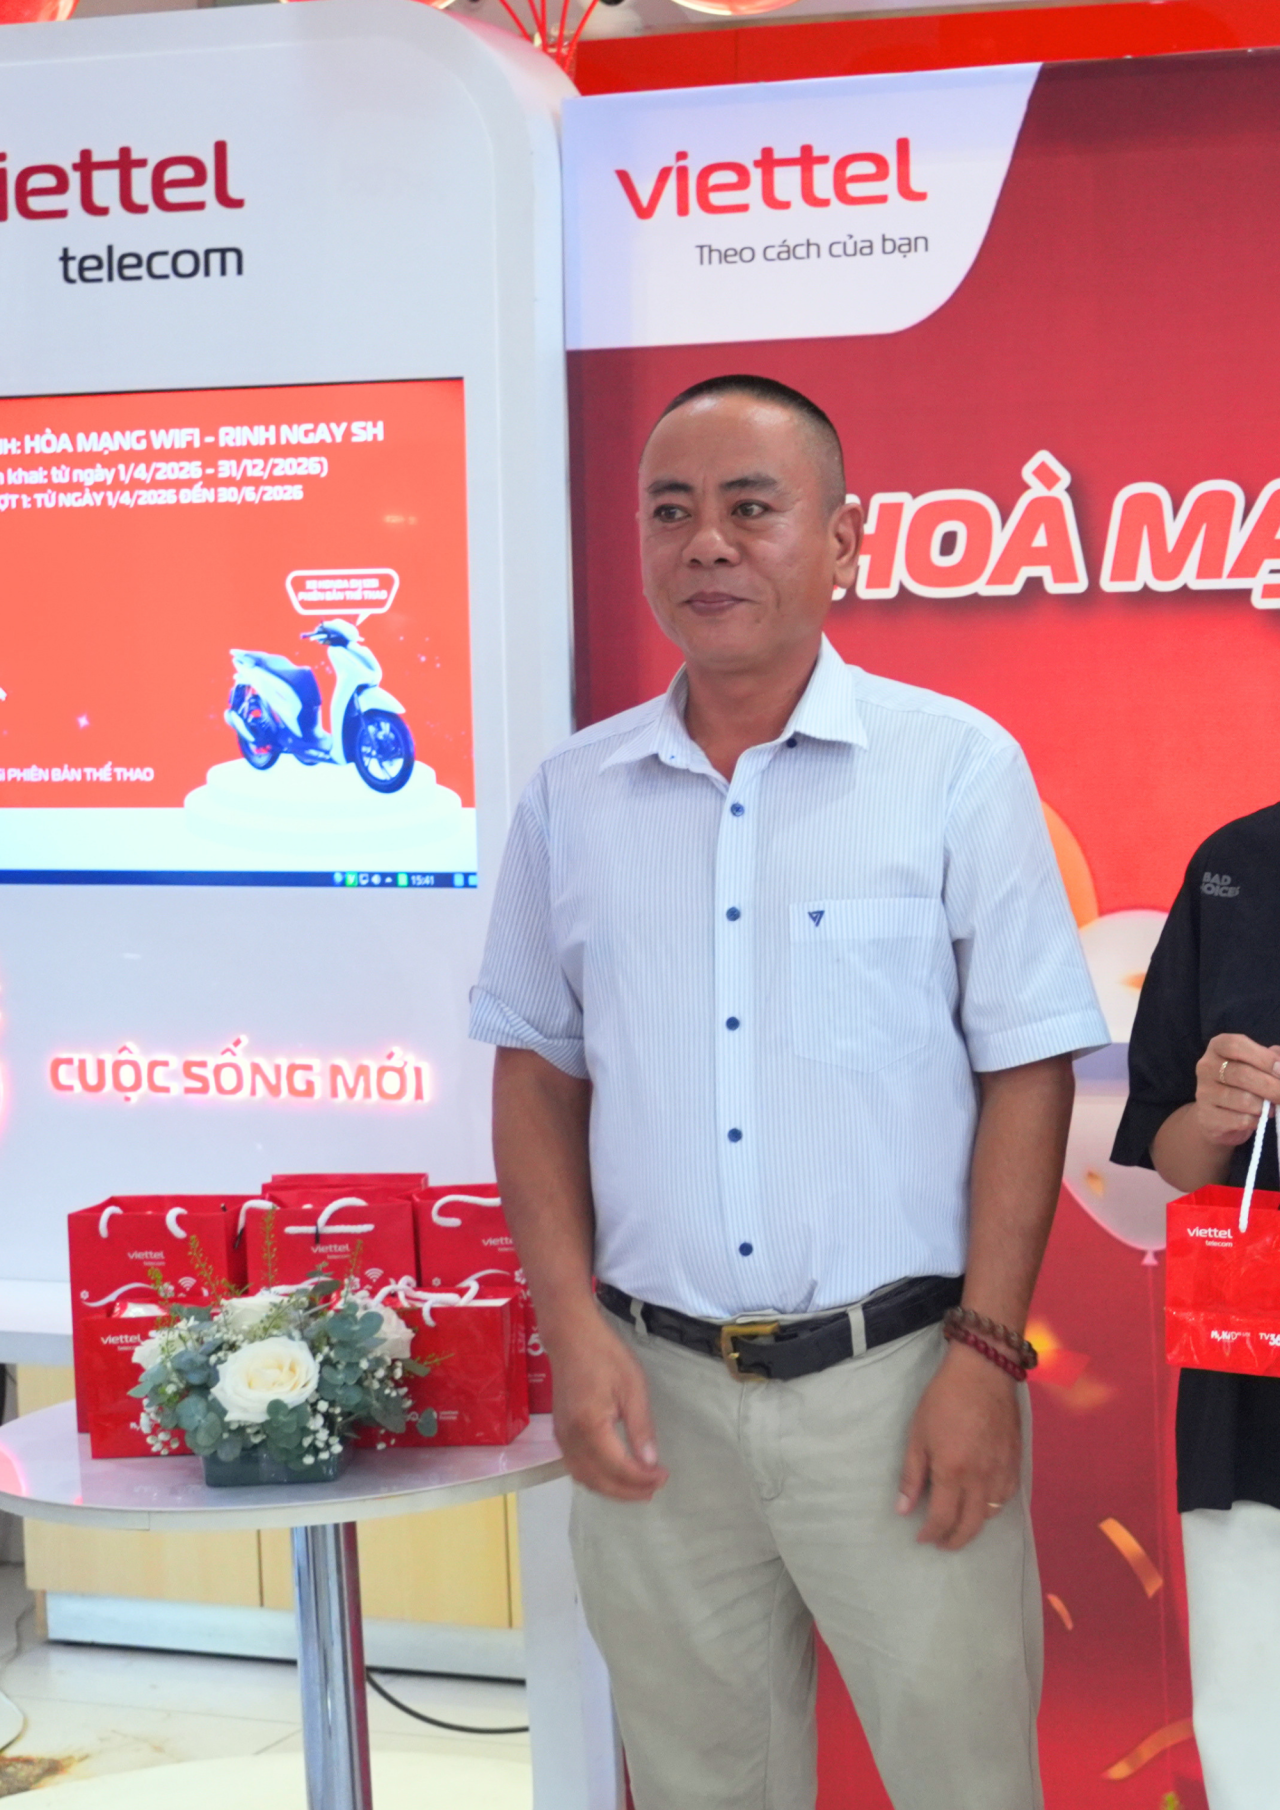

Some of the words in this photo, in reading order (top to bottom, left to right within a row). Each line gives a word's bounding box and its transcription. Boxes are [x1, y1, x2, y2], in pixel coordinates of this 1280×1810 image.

[613, 136, 929, 221] viettel
[695, 244, 756, 266] Theo
[762, 238, 821, 262] cách
[828, 234, 874, 258] của
[881, 233, 930, 259] bạn
[58, 244, 244, 285] telecom
[24, 428, 74, 455] HÒA
[76, 430, 148, 456] MẠNG
[149, 427, 201, 451] WIFI
[218, 424, 277, 448] RINH
[279, 421, 348, 446] NGAY
[350, 420, 385, 443] SH
[117, 459, 203, 485] 1/4/2026
[217, 456, 329, 482] 31/12/2026)
[216, 484, 305, 506] 30/6/2026
[7, 764, 50, 782] PHIÊN
[113, 767, 155, 782] THAO
[1202, 871, 1232, 886] BAD
[50, 1045, 172, 1102] CUỘC
[183, 1036, 318, 1099] SỐNG
[329, 1048, 426, 1102] MỚI
[1187, 1226, 1234, 1239] viettel
[1205, 1239, 1234, 1248] telecom
[127, 1250, 166, 1260] viettel
